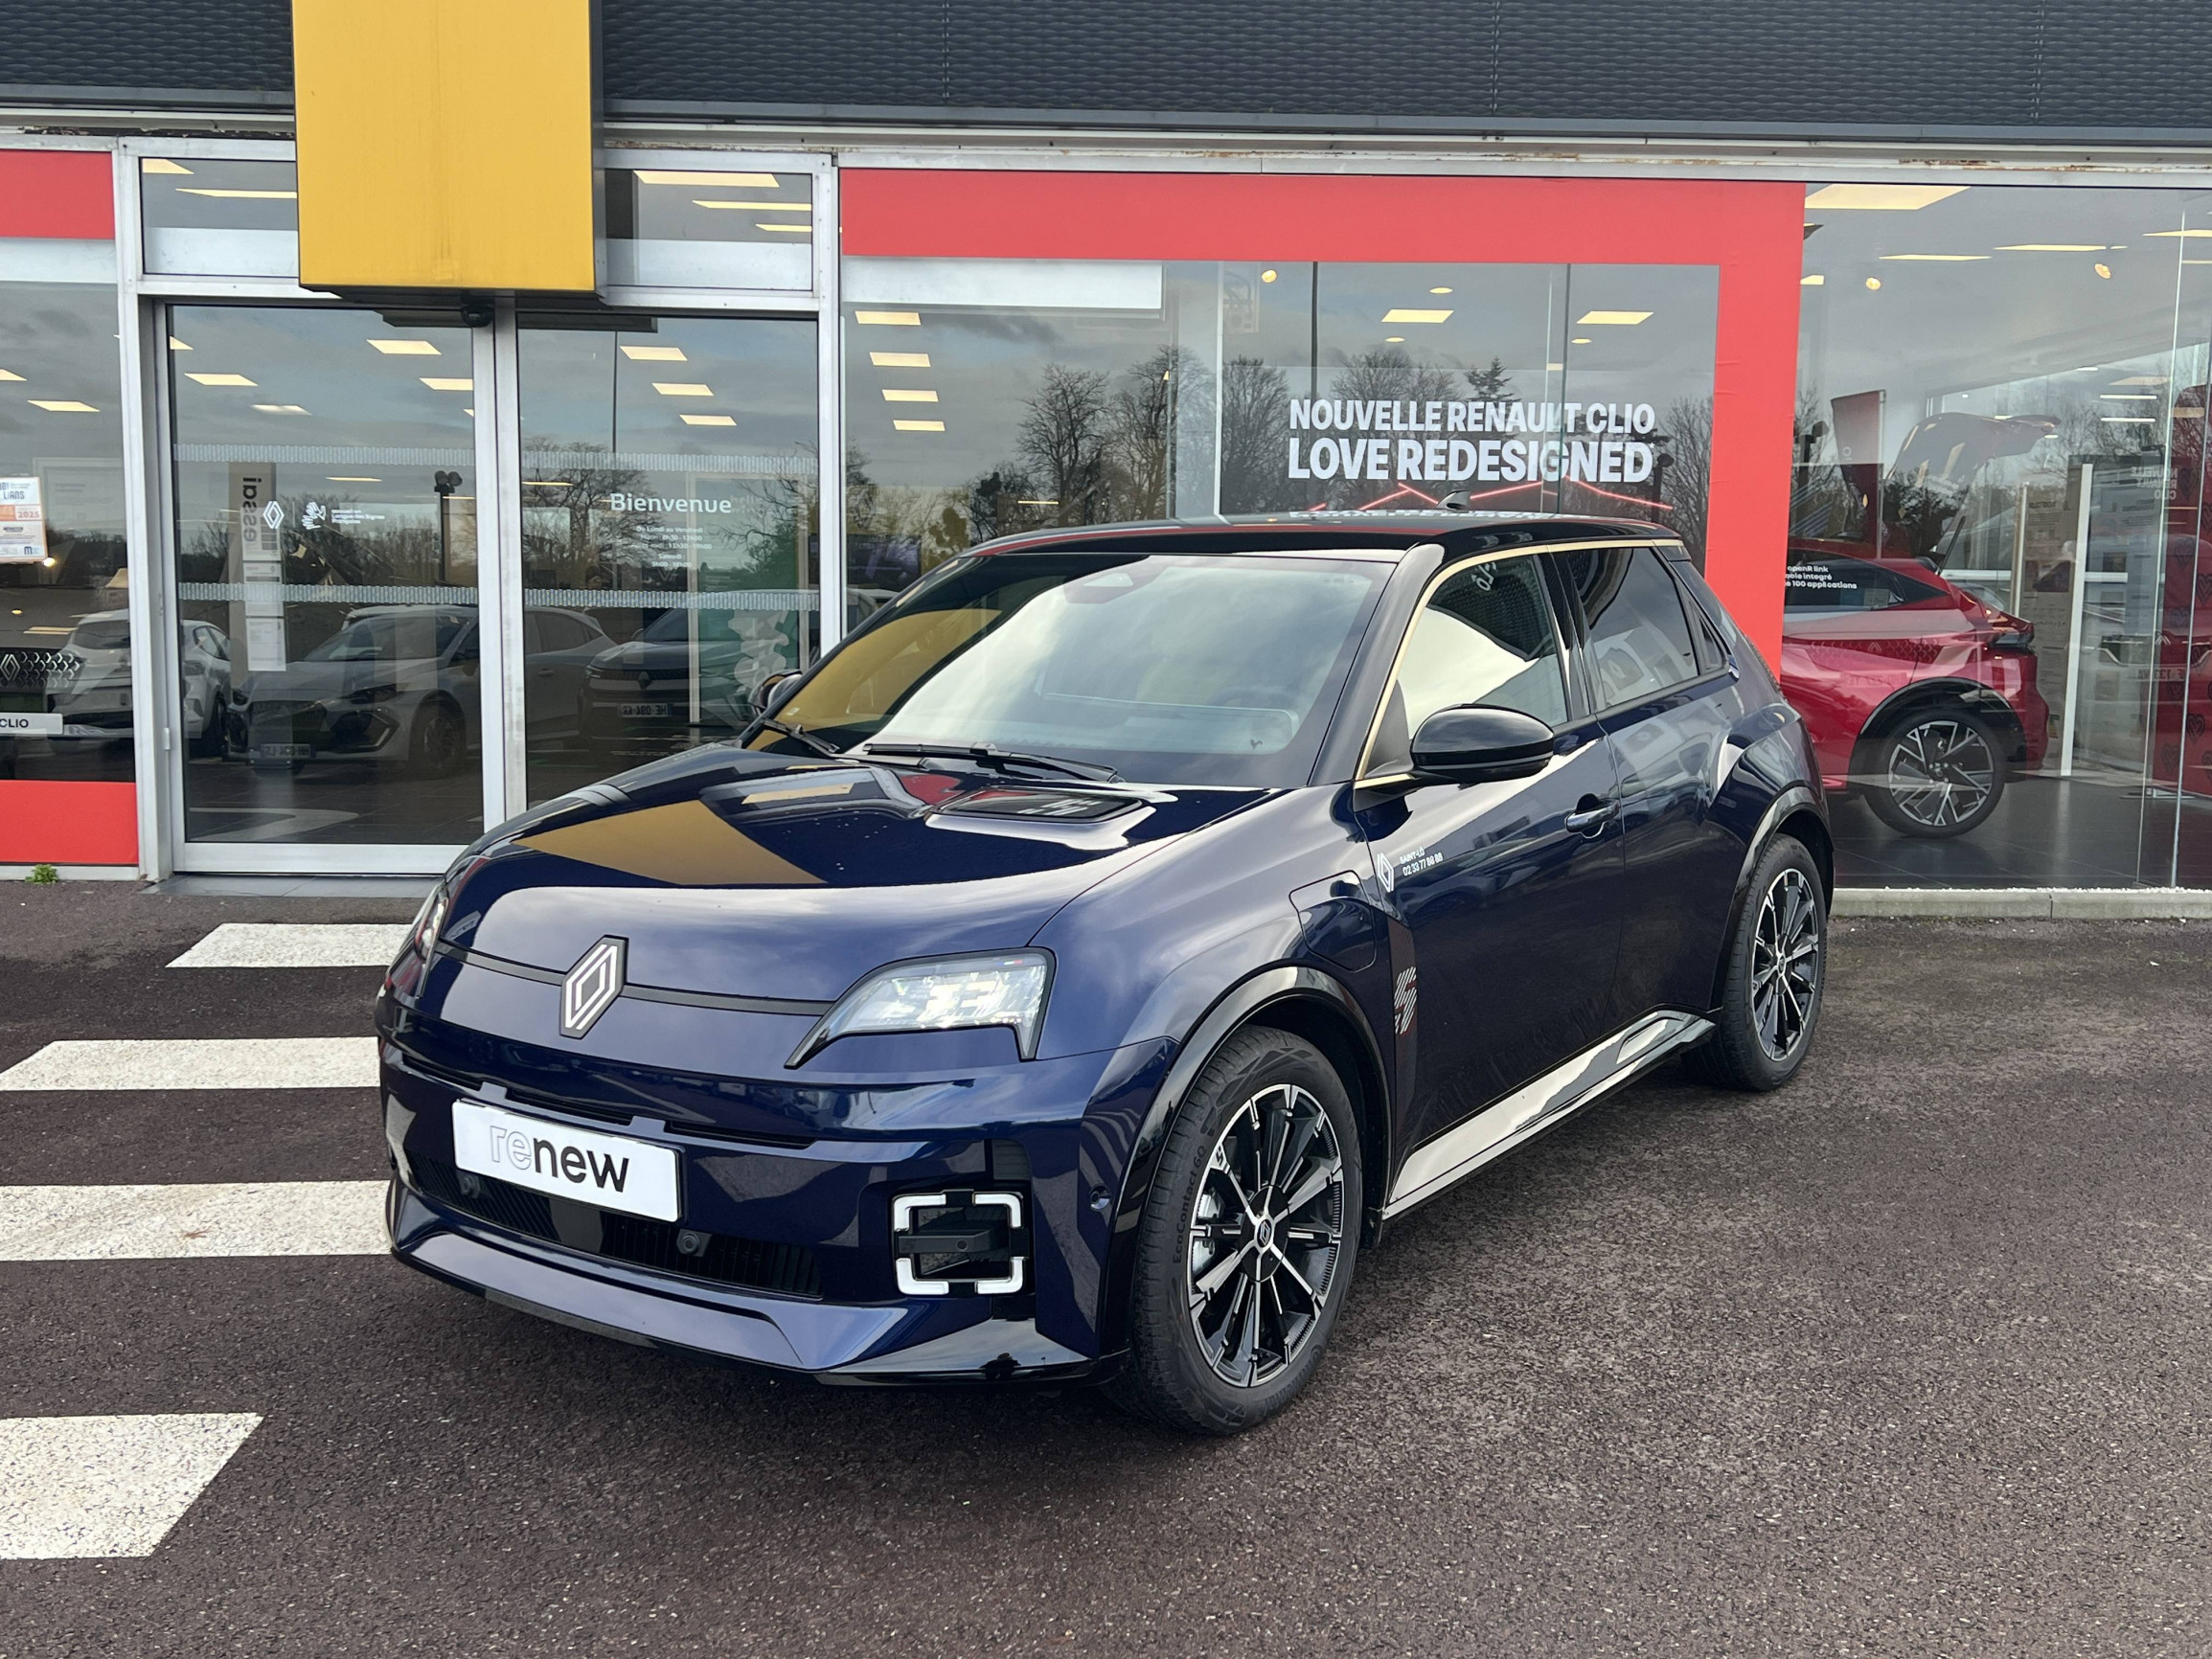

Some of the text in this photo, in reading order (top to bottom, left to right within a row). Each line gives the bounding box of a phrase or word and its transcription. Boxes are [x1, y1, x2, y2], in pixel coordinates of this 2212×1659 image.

[1289, 398, 1655, 434] NOUVELLE RENAULT CLIO
[1288, 437, 1389, 480] LOVE
[609, 492, 732, 513] Bienvenue
[0, 718, 30, 728] CLIO
[1402, 864, 1412, 876] 02
[1411, 861, 1420, 874] 33
[1419, 858, 1426, 870] 77
[490, 1125, 629, 1193] renew
[1173, 1171, 1198, 1264] EcoContact
